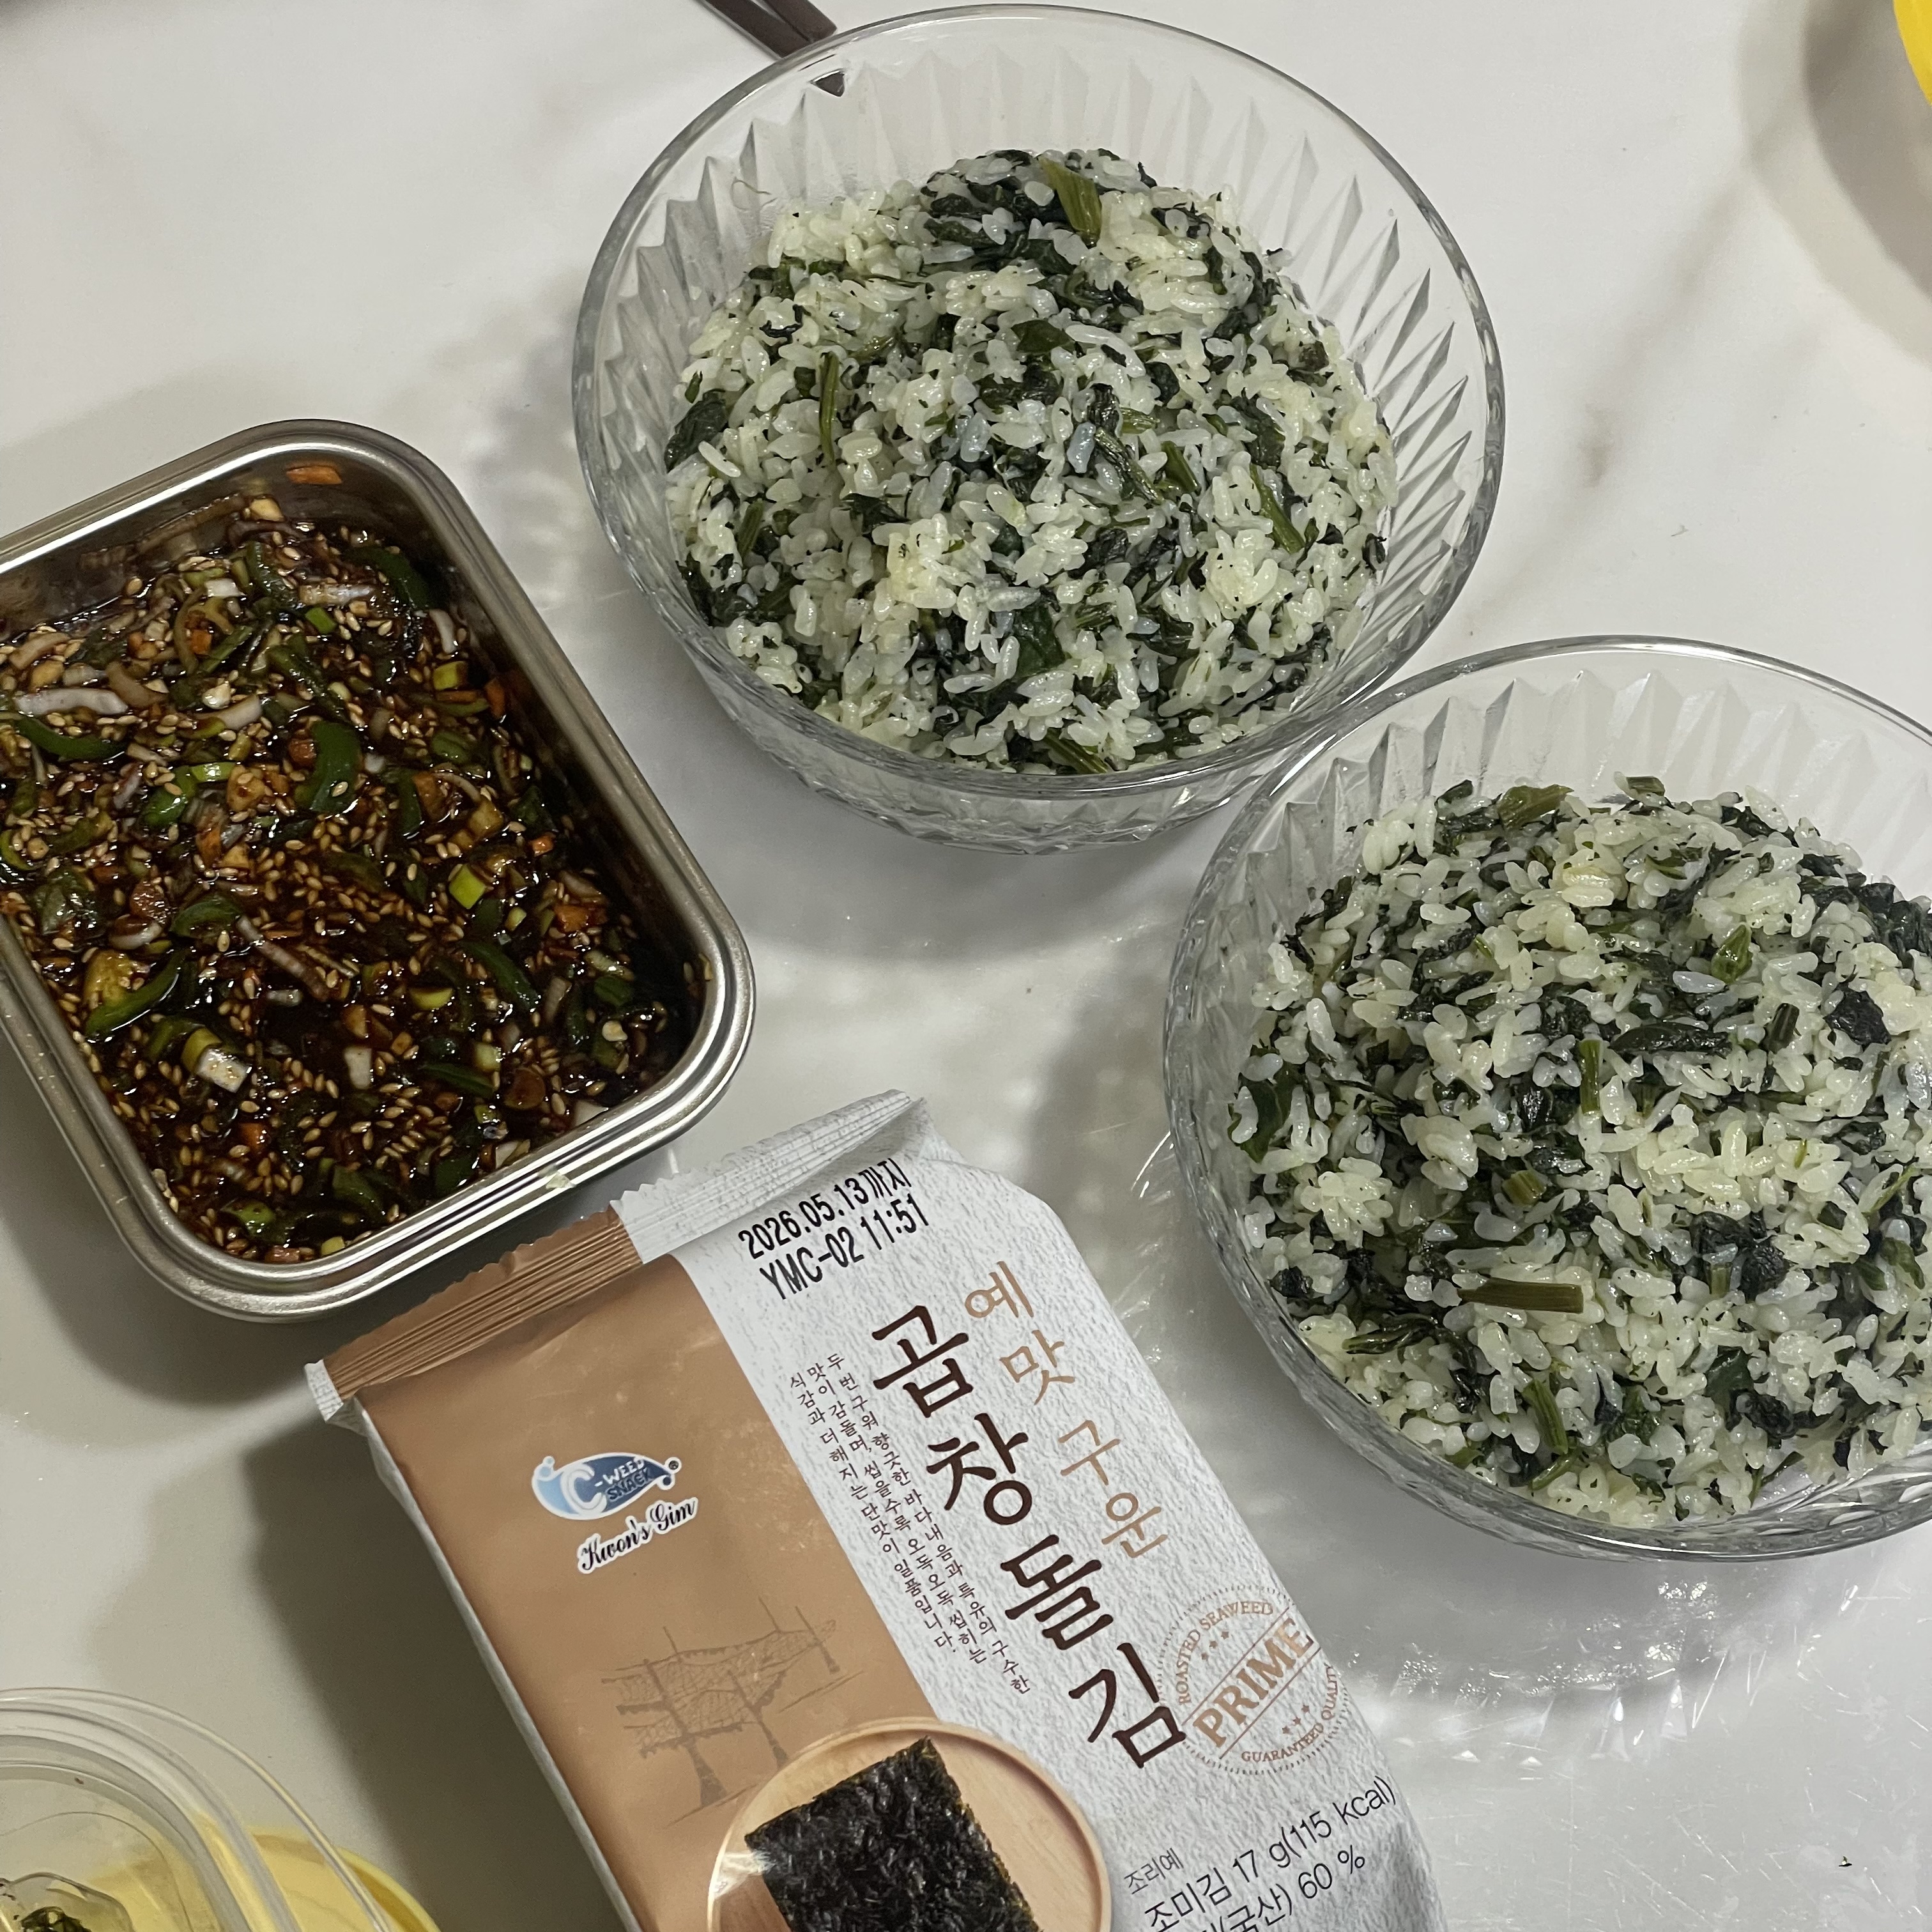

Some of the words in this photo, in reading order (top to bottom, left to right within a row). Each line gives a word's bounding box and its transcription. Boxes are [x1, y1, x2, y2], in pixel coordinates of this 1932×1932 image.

[738, 1158, 912, 1259] 2026.05.13까지
[759, 1227, 865, 1300] YMC-02
[860, 1193, 929, 1250] 11:51
[965, 1261, 1075, 1405] 예맛
[1058, 1420, 1168, 1558] 구운
[581, 1519, 652, 1571] Kwon's
[650, 1500, 696, 1531] Gim
[607, 1468, 652, 1499] SNACK
[790, 1372, 825, 1425] 식감과
[820, 1427, 869, 1500] 더해지는
[861, 1503, 901, 1554] 단맛이
[894, 1559, 956, 1653] 일품입니다.
[806, 1363, 836, 1395] 맛이
[828, 1400, 872, 1453] 감돌며,
[864, 1460, 911, 1531] 씹을수록
[908, 1538, 954, 1606] 오독오독
[949, 1609, 987, 1664] 씹히는
[827, 1353, 845, 1370] 두
[839, 1372, 859, 1391] 번
[850, 1395, 878, 1430] 구워
[870, 1432, 911, 1486] 향긋한
[904, 1489, 963, 1579] 바다내음과
[958, 1583, 997, 1635] 특유의
[992, 1640, 1031, 1694] 구수한
[871, 1305, 1186, 1769] 곱창돌김
[1175, 1629, 1201, 1705] ROASTED
[1199, 1600, 1274, 1630] SEAWEED
[1192, 1617, 1314, 1748] PRIME
[1241, 1722, 1324, 1763] GUARANTEED
[1124, 1848, 1184, 1895] 조리예
[1144, 1867, 1232, 1932] 조미김
[1232, 1850, 1259, 1882] 17
[1332, 1775, 1397, 1825] kcal)
[1298, 1863, 1333, 1899] 60
[1338, 1844, 1365, 1874] %
